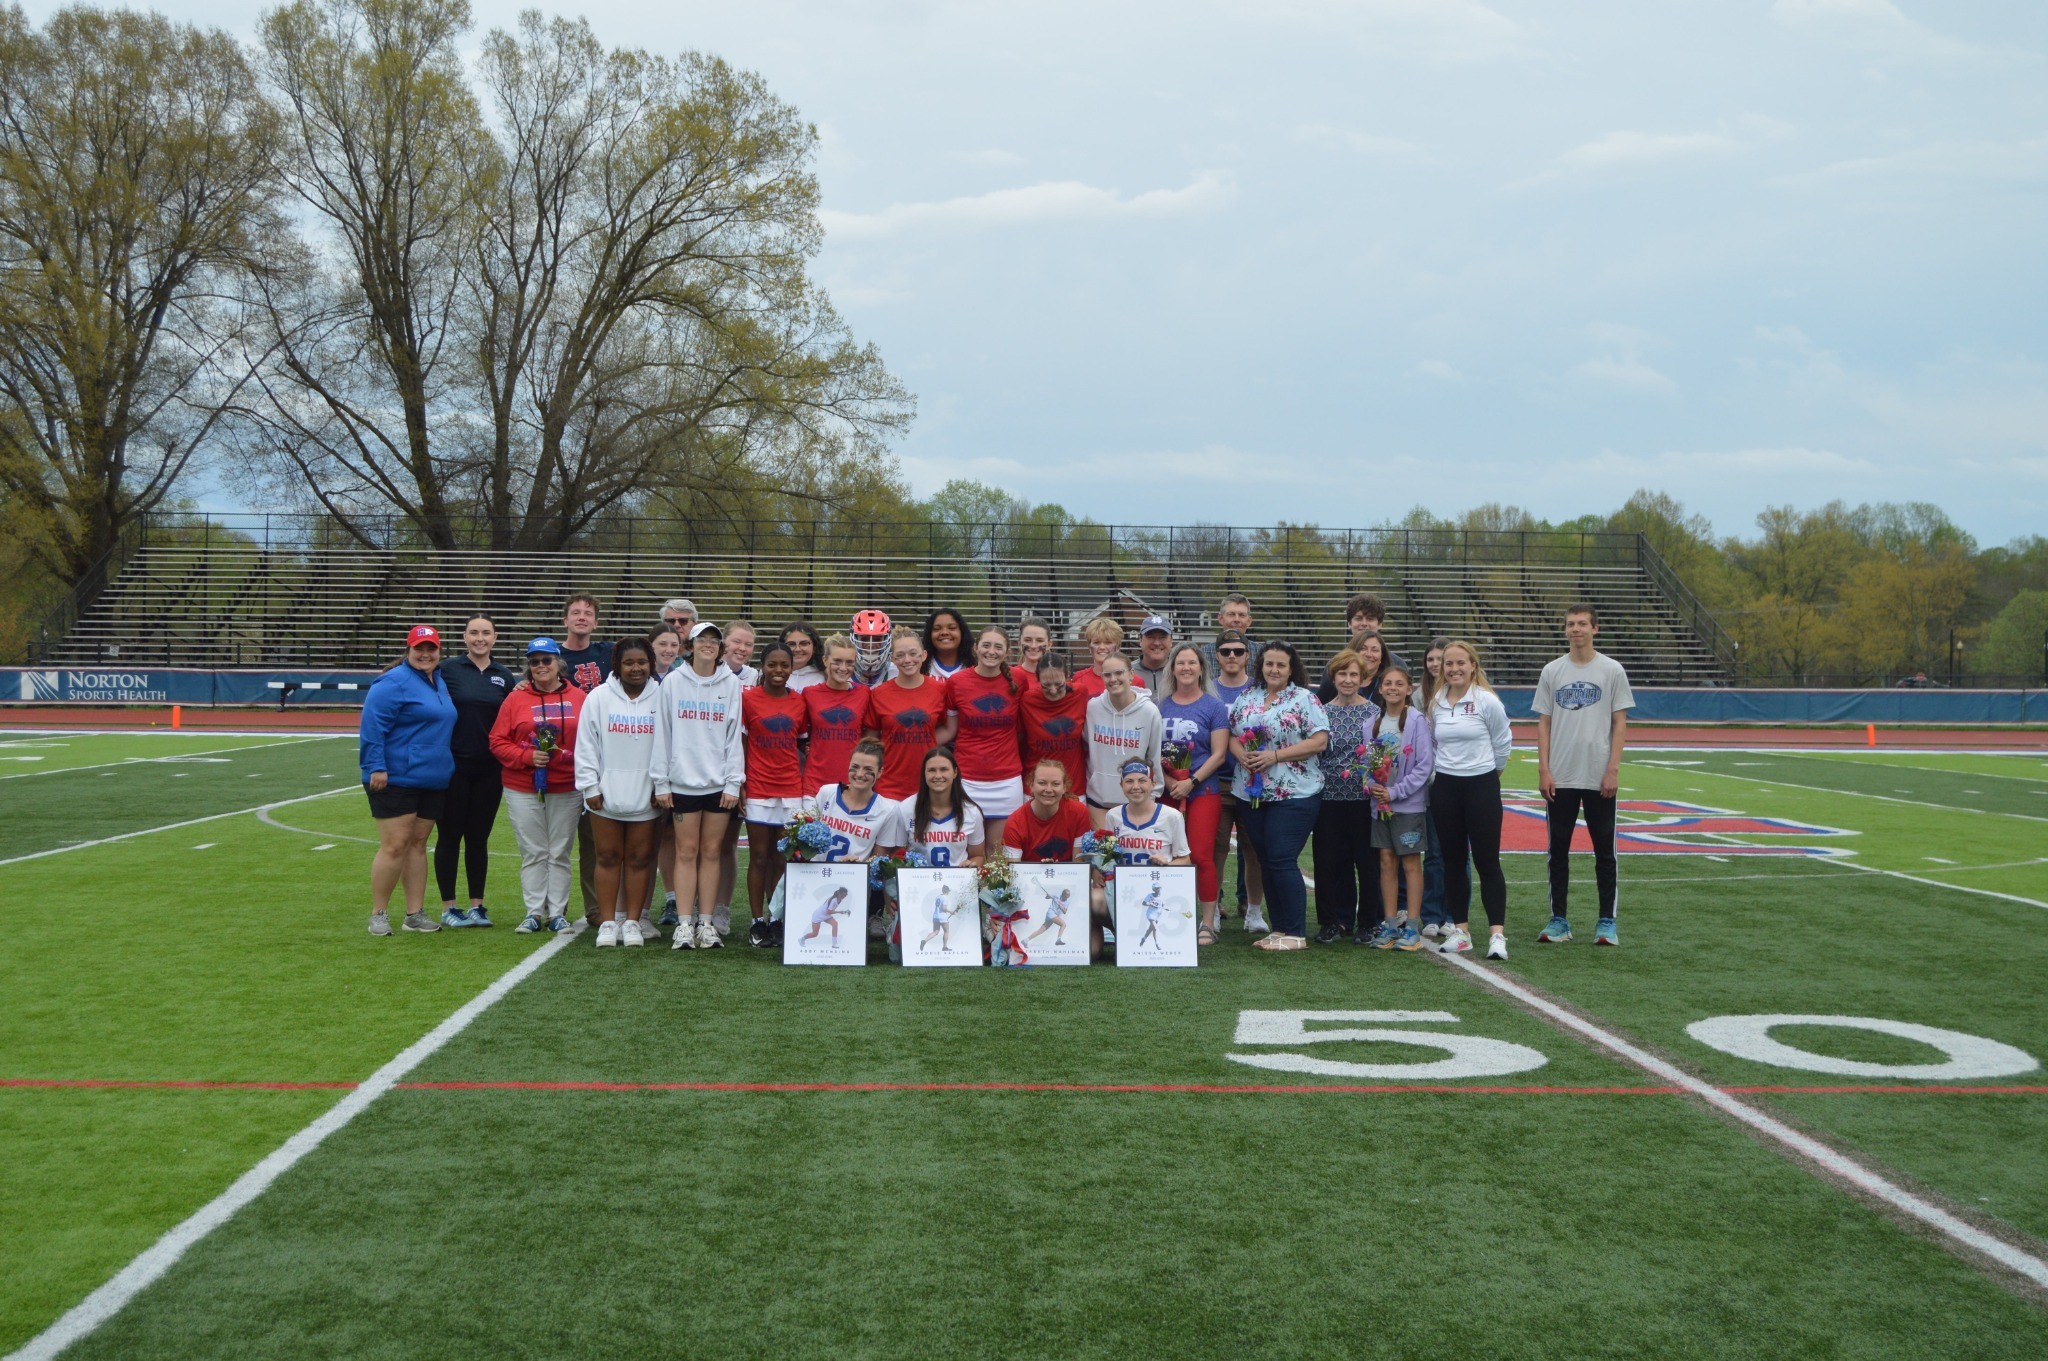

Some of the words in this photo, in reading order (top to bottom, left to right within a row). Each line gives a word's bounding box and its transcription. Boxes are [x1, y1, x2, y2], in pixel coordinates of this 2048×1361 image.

[68, 671, 149, 688] NORTON
[69, 689, 114, 700] SPORTS
[117, 689, 166, 700] HEALTH
[678, 699, 726, 712] HANOVER
[608, 713, 655, 725] HANOVER
[677, 709, 725, 722] LACROSSE
[608, 722, 655, 734] LACROSSE
[1094, 724, 1141, 740] HANOVER
[756, 735, 796, 749] PANTHER
[1093, 732, 1140, 749] LACROSSE
[821, 814, 871, 839] HANOVER
[914, 831, 966, 843] HANOVER
